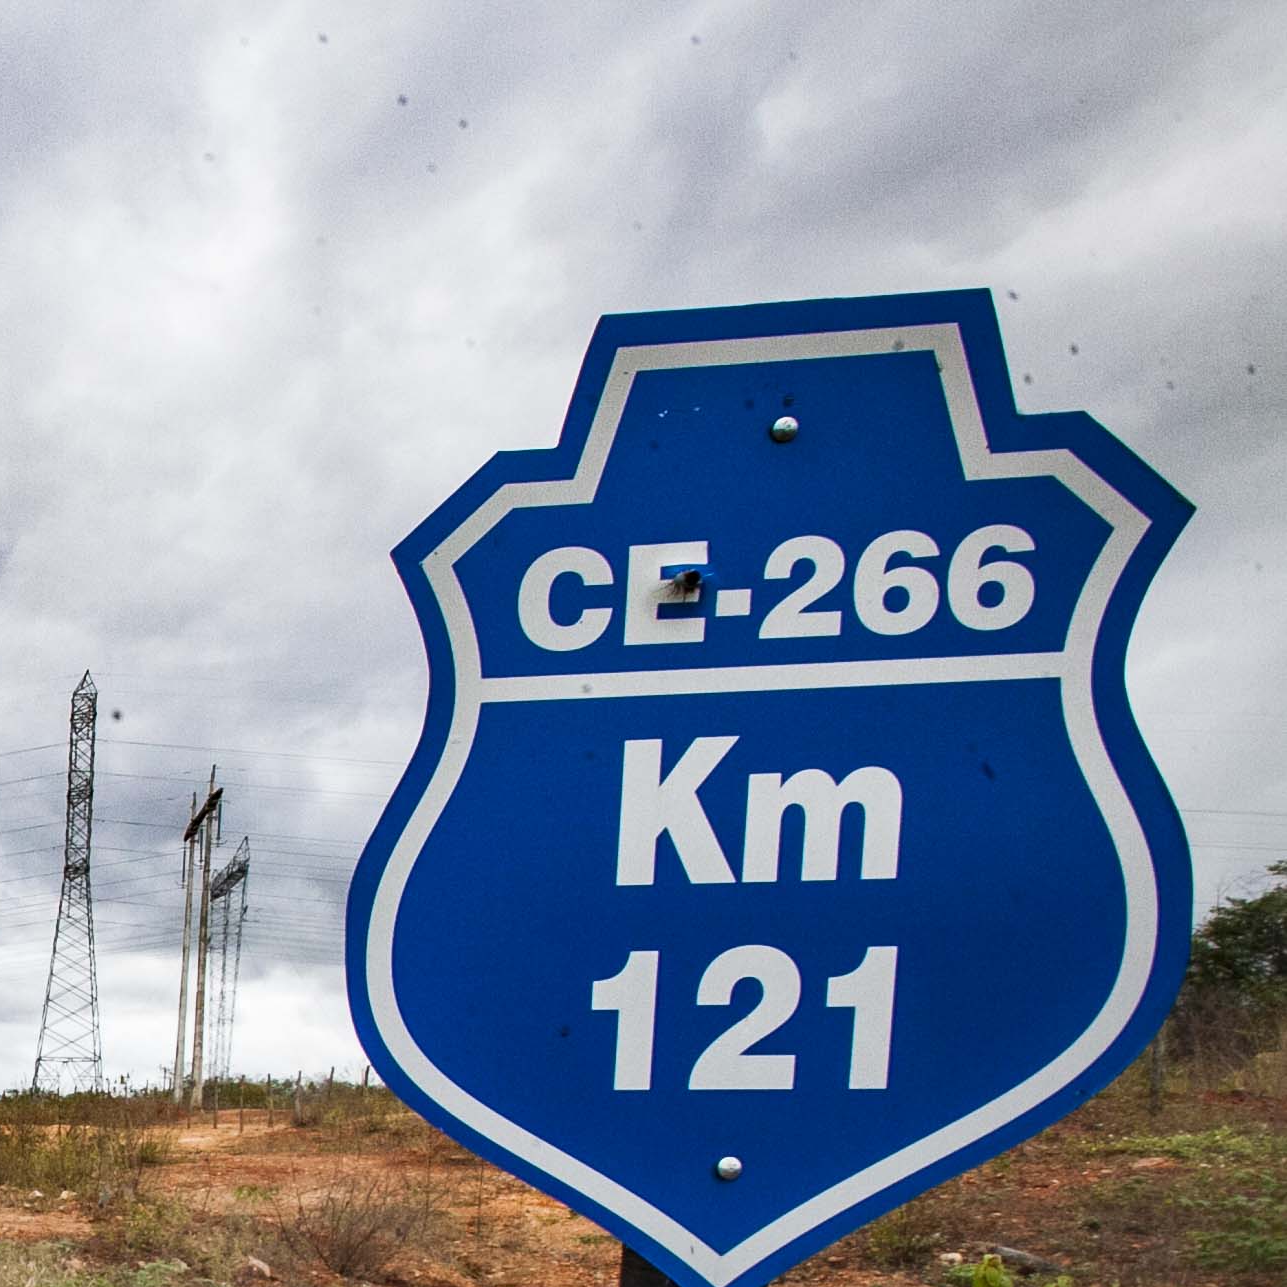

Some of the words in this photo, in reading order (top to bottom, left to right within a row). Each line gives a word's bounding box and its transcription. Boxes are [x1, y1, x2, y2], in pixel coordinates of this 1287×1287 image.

[518, 524, 1035, 652] CE-266
[616, 735, 903, 886] Km
[591, 944, 898, 1091] 121
